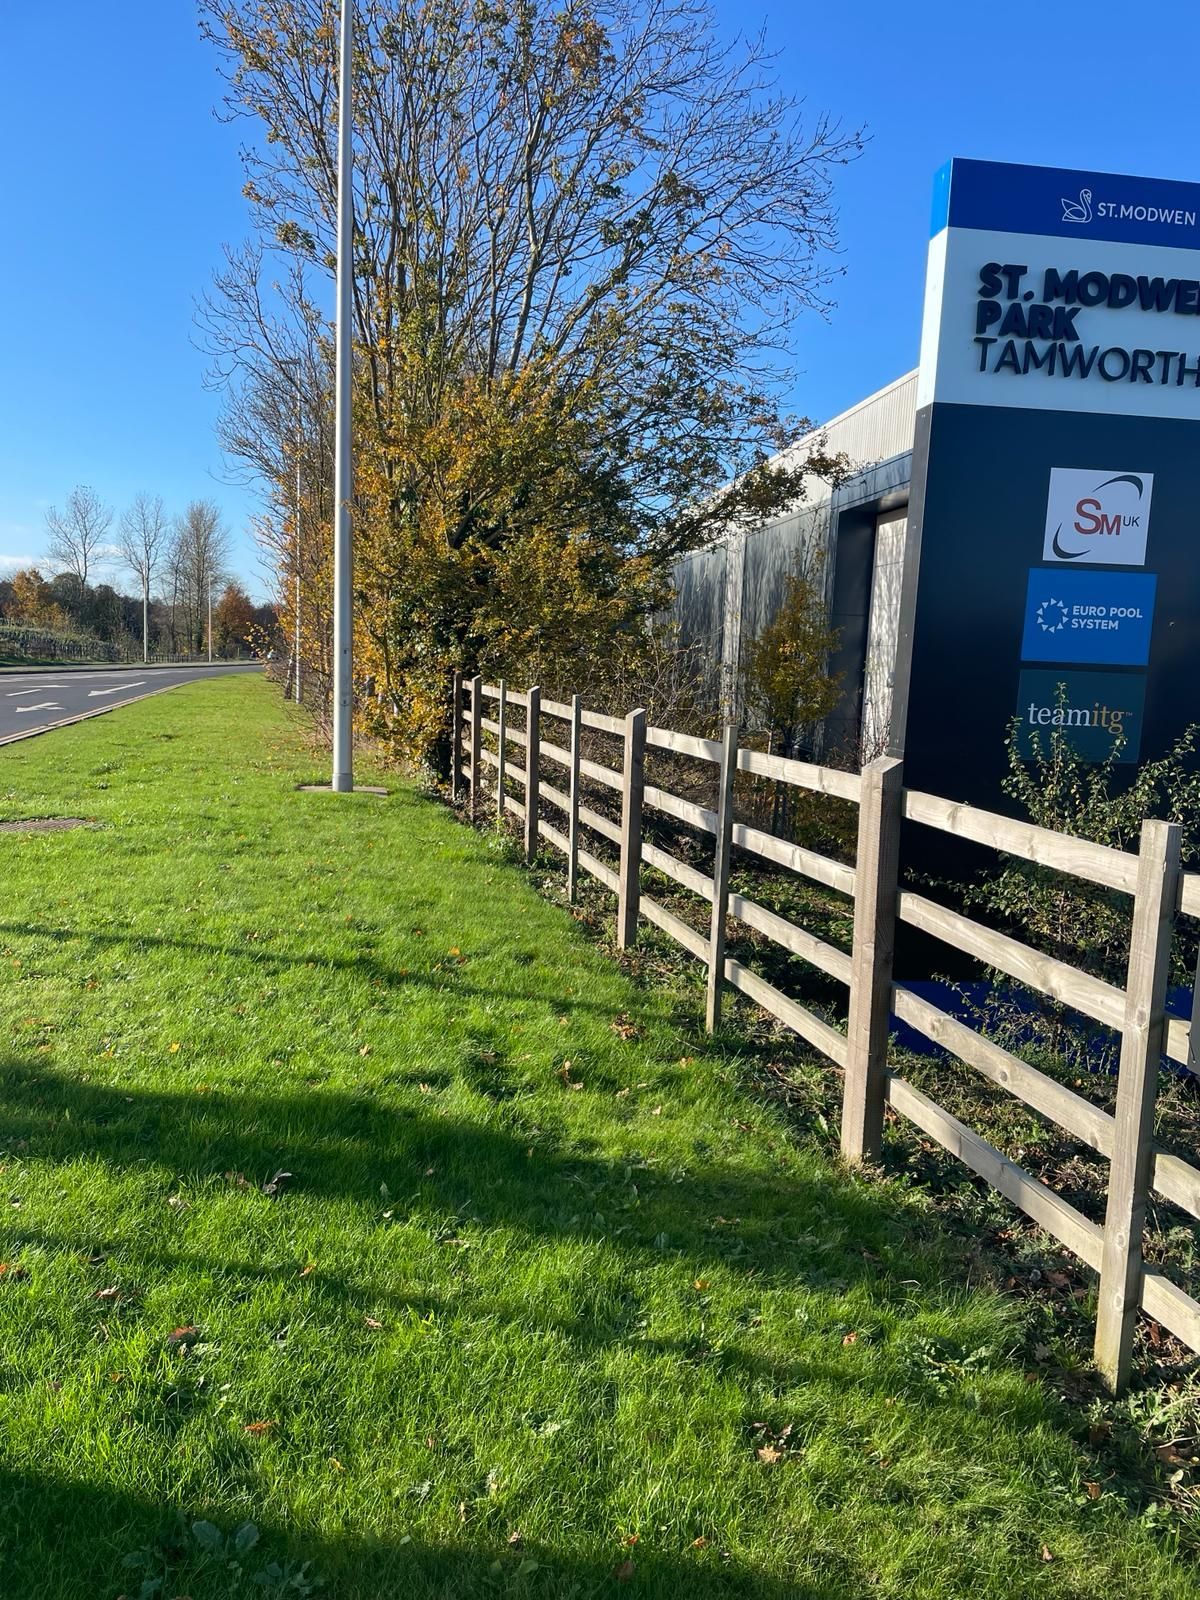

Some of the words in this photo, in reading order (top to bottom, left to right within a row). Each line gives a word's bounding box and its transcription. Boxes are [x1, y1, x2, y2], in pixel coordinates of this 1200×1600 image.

[978, 262, 1035, 301] ST.
[1042, 268, 1200, 316] MODWE
[975, 300, 1082, 341] PARK
[973, 337, 1200, 388] TAMWORTH
[1071, 618, 1119, 630] SYSTEM
[1072, 605, 1107, 617] EURO
[1109, 607, 1143, 619] POOL
